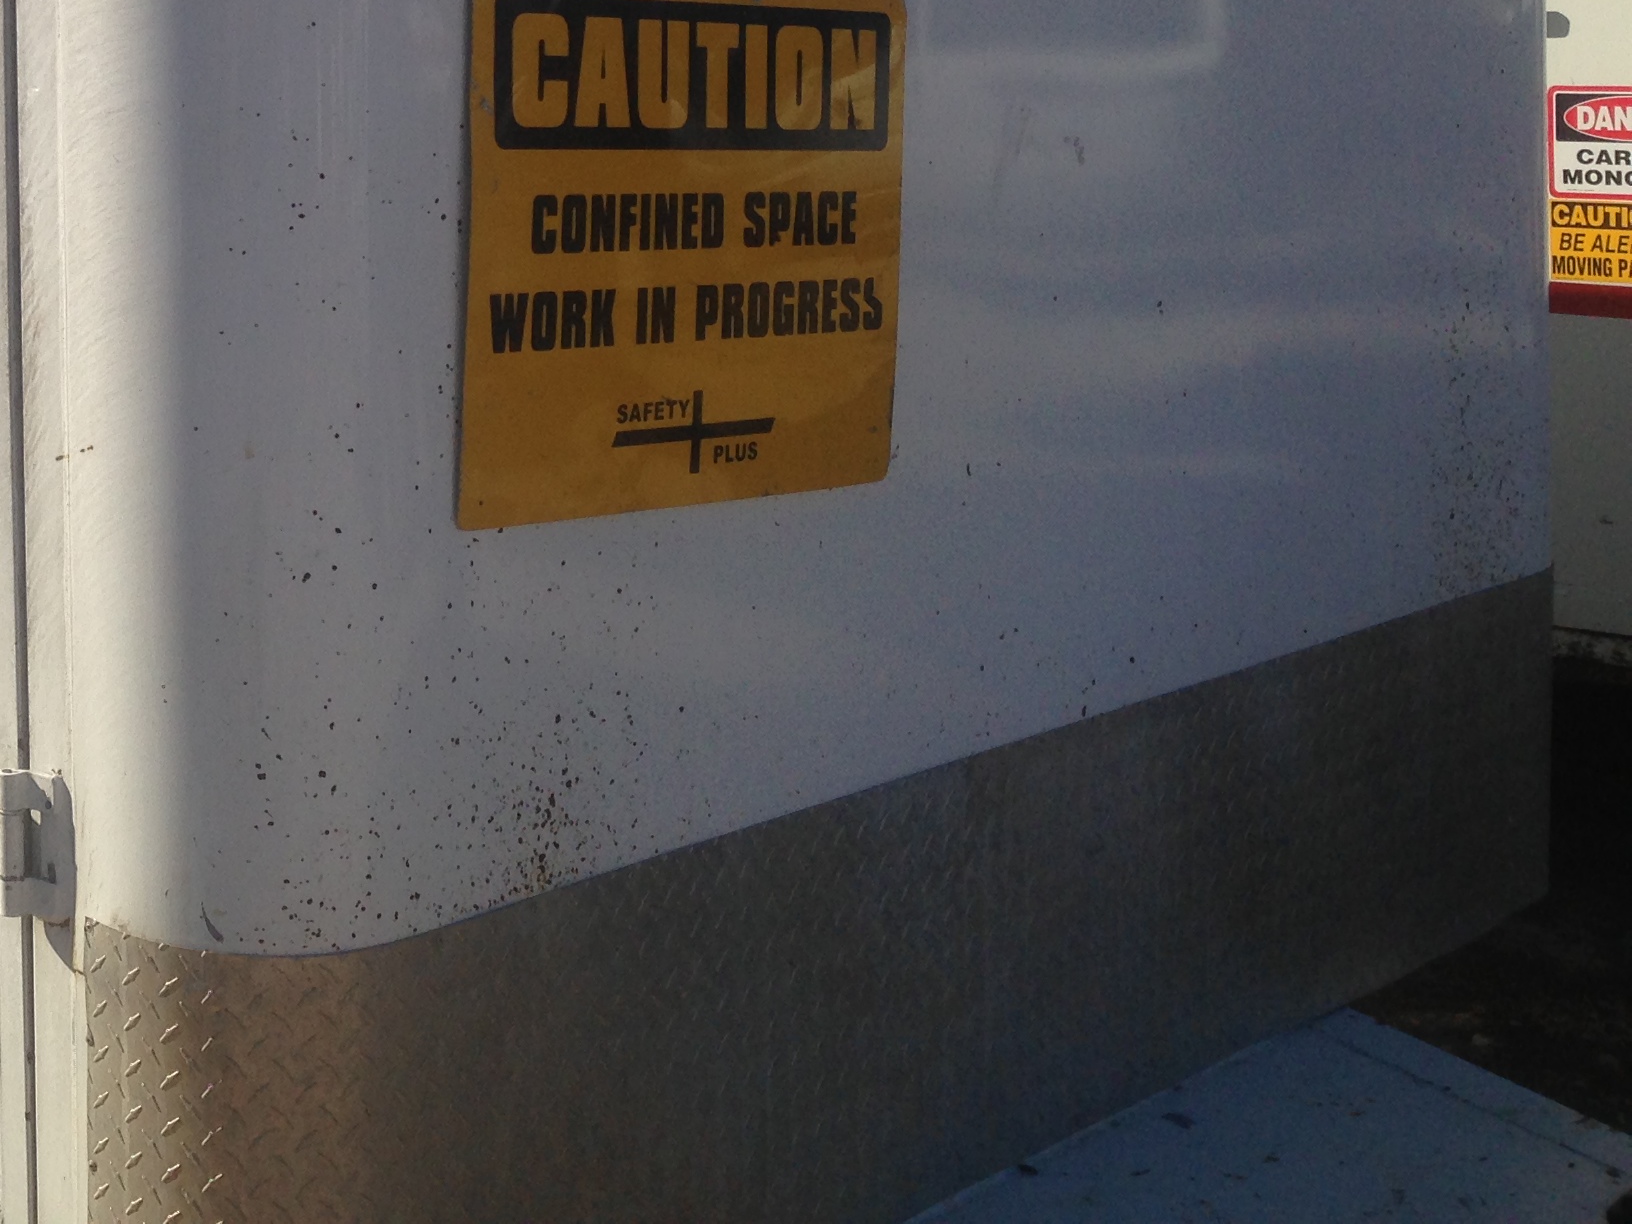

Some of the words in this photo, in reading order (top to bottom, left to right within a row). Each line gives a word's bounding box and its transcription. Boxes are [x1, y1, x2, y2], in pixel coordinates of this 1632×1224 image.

[512, 12, 877, 131] CAUTION
[531, 193, 724, 254] CONFINED
[743, 191, 857, 247] SPACE
[1553, 203, 1632, 228] CAUTI
[1559, 232, 1586, 252] BE
[1552, 255, 1613, 278] MOVING
[489, 289, 616, 354] WORK
[636, 287, 676, 344] IN
[695, 278, 883, 341] PROGRESS
[616, 399, 690, 424] SAFETY
[713, 441, 759, 464] PLUS
